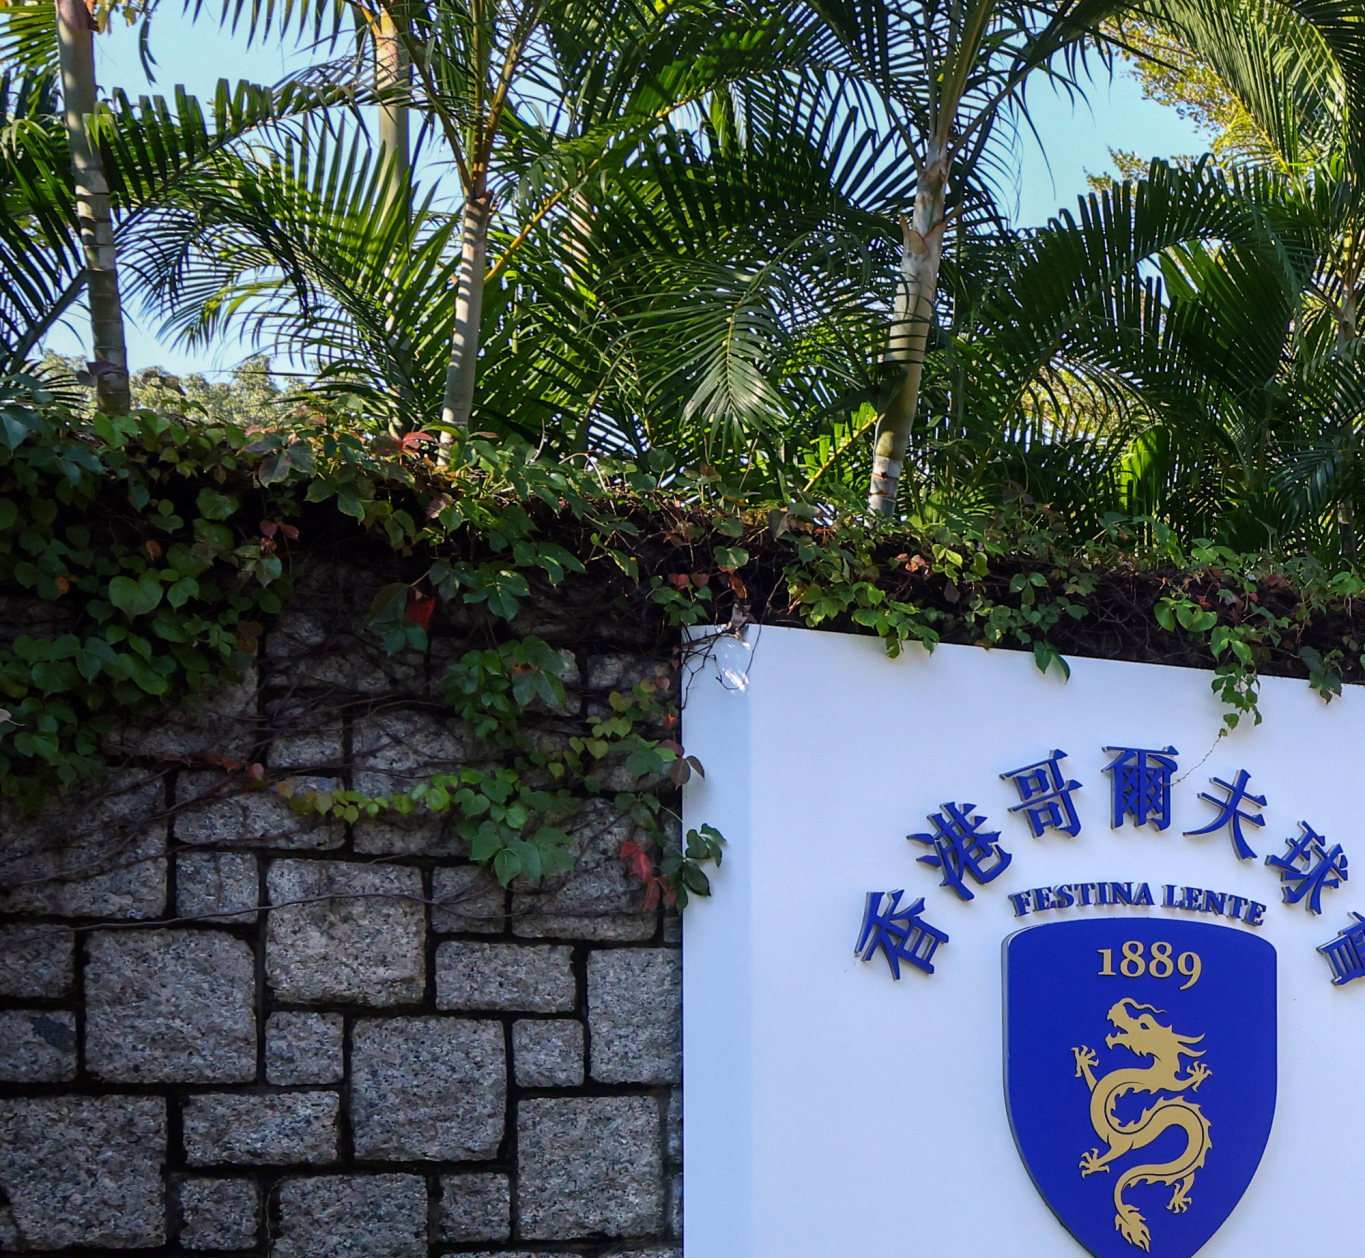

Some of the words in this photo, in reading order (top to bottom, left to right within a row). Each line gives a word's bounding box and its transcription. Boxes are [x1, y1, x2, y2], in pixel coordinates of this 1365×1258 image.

[1009, 880, 1155, 918] FESTINA
[1162, 883, 1267, 926] LENTE
[1097, 940, 1202, 990] 1889
